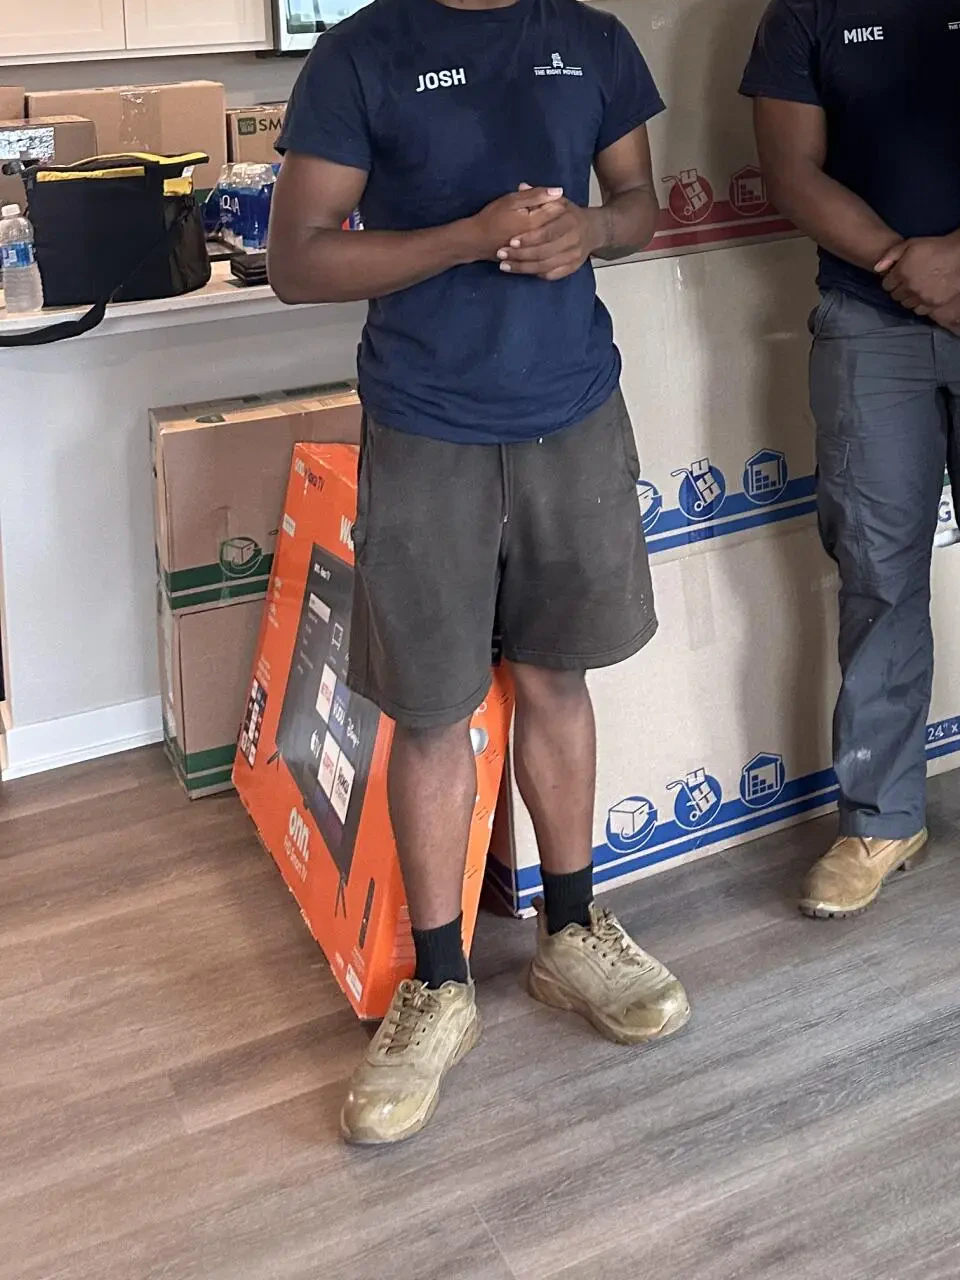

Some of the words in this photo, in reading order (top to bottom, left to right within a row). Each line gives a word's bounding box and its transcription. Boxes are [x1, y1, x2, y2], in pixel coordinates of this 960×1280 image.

[843, 26, 884, 44] MIKE
[416, 68, 467, 93] JOSH
[927, 722, 948, 741] 24"
[951, 723, 959, 734] x
[289, 806, 310, 863] onn.
